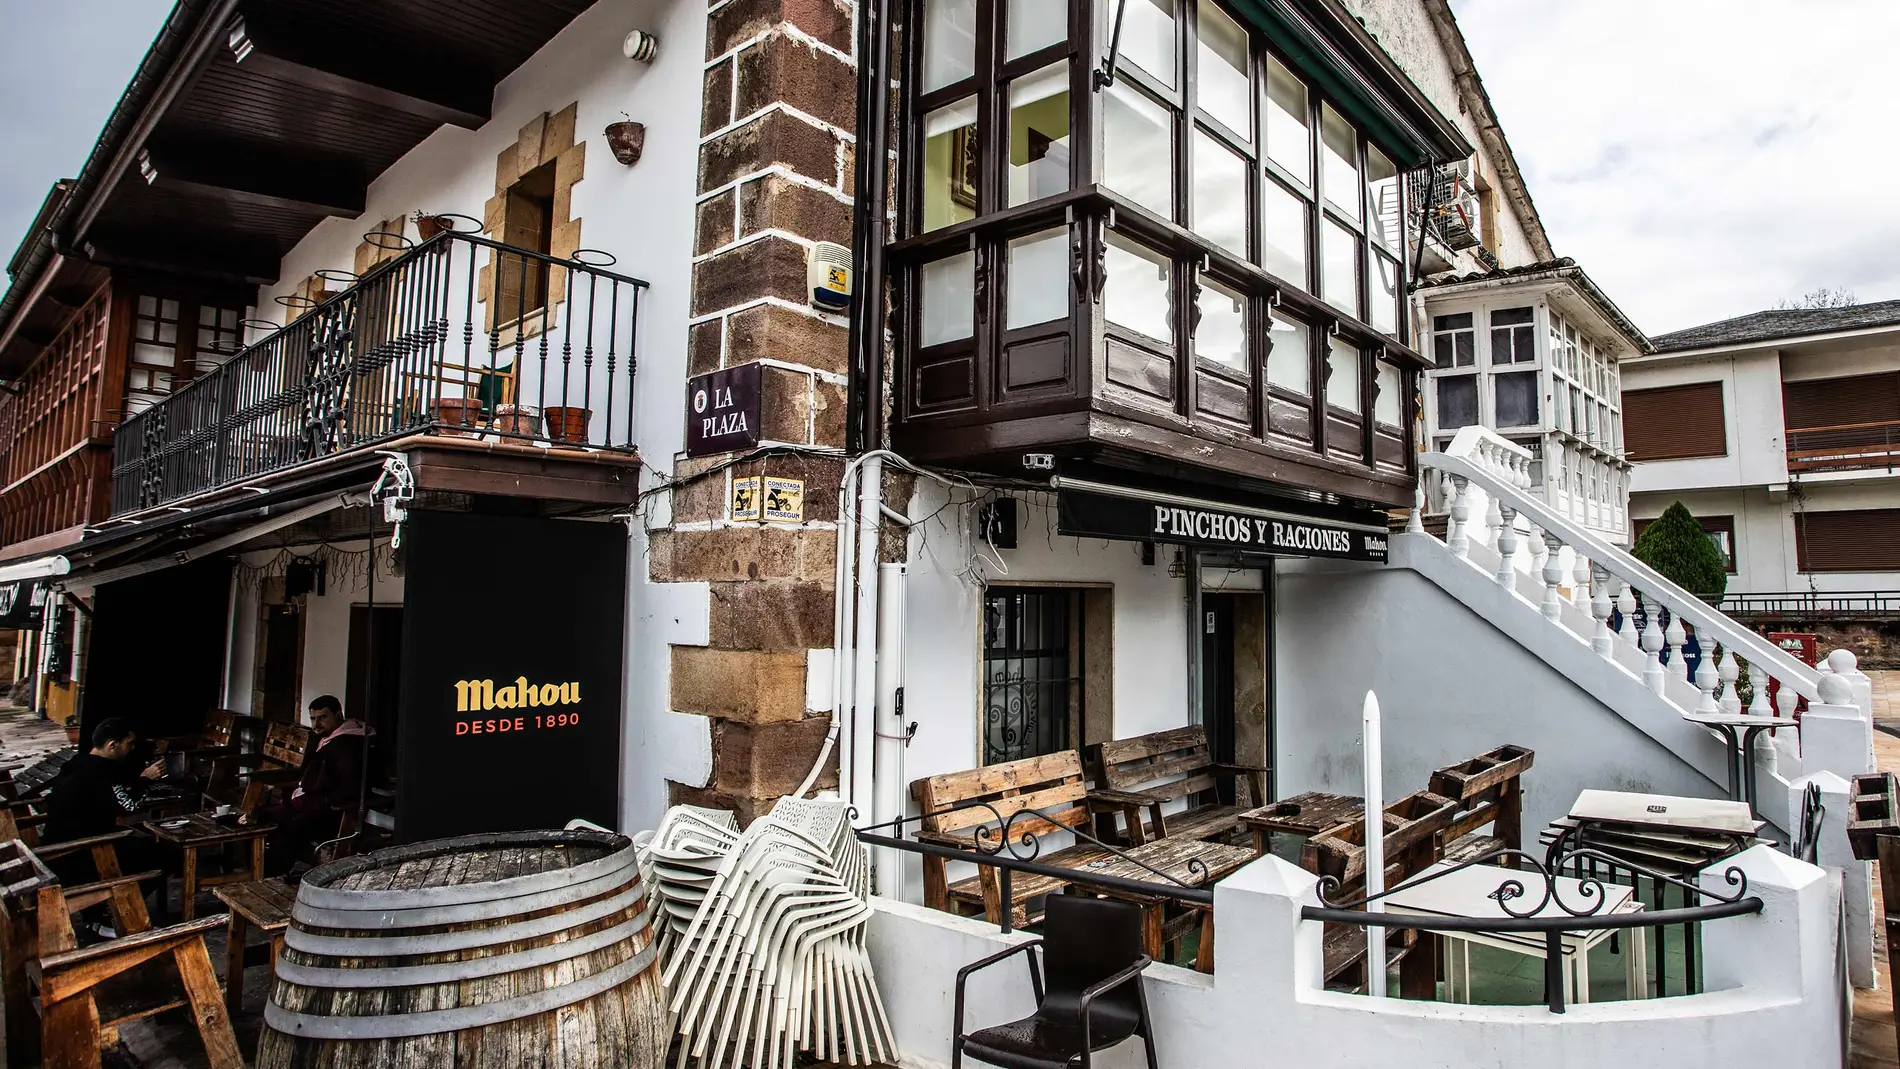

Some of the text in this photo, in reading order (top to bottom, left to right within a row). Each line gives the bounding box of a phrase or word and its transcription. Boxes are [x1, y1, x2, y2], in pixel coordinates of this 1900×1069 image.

[714, 386, 733, 409] LA
[702, 411, 748, 438] PLAZA
[767, 480, 801, 489] CONECTADA
[1155, 506, 1350, 552] PINCHOS Y RACIONES
[454, 676, 582, 712] Mahou
[456, 713, 579, 735] DESDE 1890
